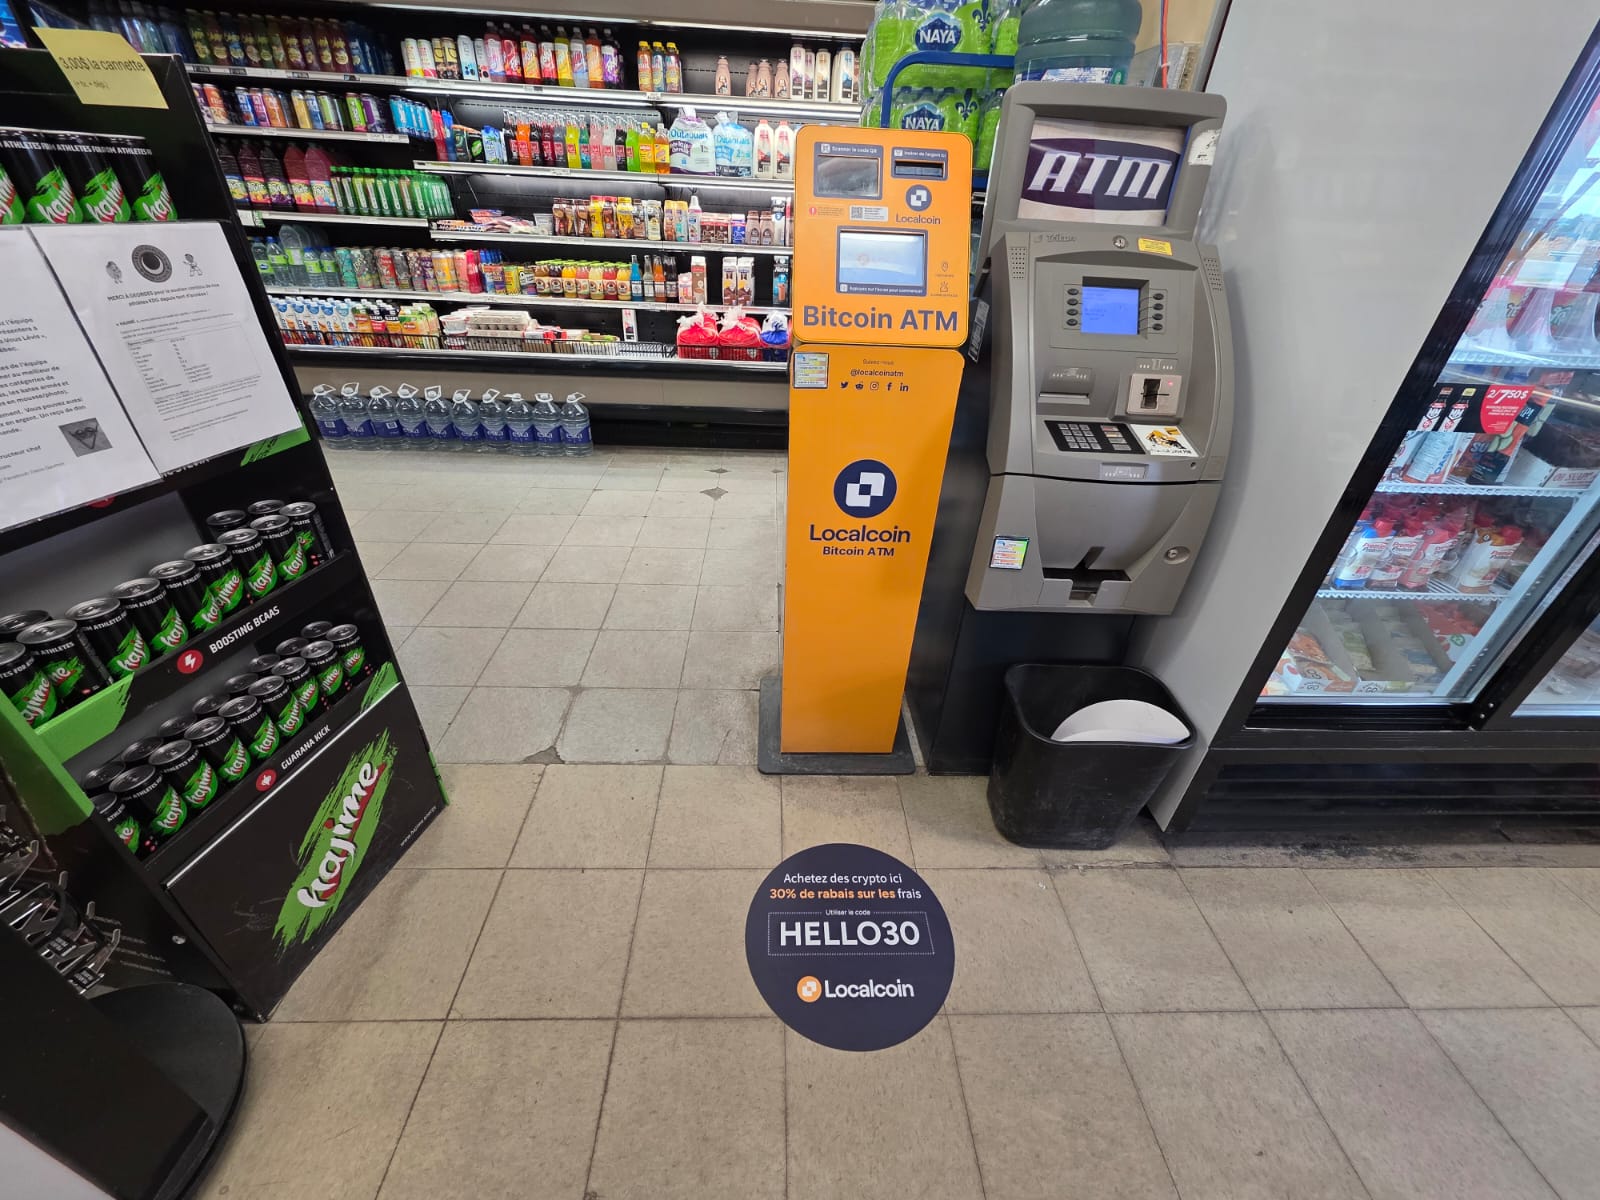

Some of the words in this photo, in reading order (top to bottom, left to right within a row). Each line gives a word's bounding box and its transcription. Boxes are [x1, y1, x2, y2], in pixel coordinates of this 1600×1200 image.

[919, 28, 956, 45] NAYA
[100, 59, 146, 72] cannette
[905, 117, 940, 131] NAYA
[5, 140, 41, 151] ATHLETES
[56, 143, 92, 153] ATHLETES
[1027, 150, 1173, 200] ATM
[895, 212, 941, 225] Localcoin
[803, 304, 893, 329] Bitcoin
[899, 308, 958, 332] ATM
[850, 368, 904, 377] @localcoinatm
[809, 523, 911, 543] Localcoin
[822, 546, 865, 556] Bitcoin
[867, 547, 895, 557] ATM
[209, 621, 253, 654] BOOSTING
[253, 605, 281, 629] BCAAS
[281, 737, 315, 770] GUARANA
[315, 724, 331, 743] KICK
[297, 761, 381, 908] hajime
[783, 873, 828, 884] Achetez
[829, 873, 850, 884] des
[851, 873, 888, 886] crypto
[889, 872, 903, 884] ici
[769, 888, 797, 899] 30%
[799, 888, 815, 899] de
[817, 888, 855, 899] rabais
[857, 890, 875, 899] sur
[878, 888, 896, 899] les
[897, 888, 922, 899] frais
[780, 920, 920, 946] HELLO30
[824, 978, 915, 998] Localcoin
